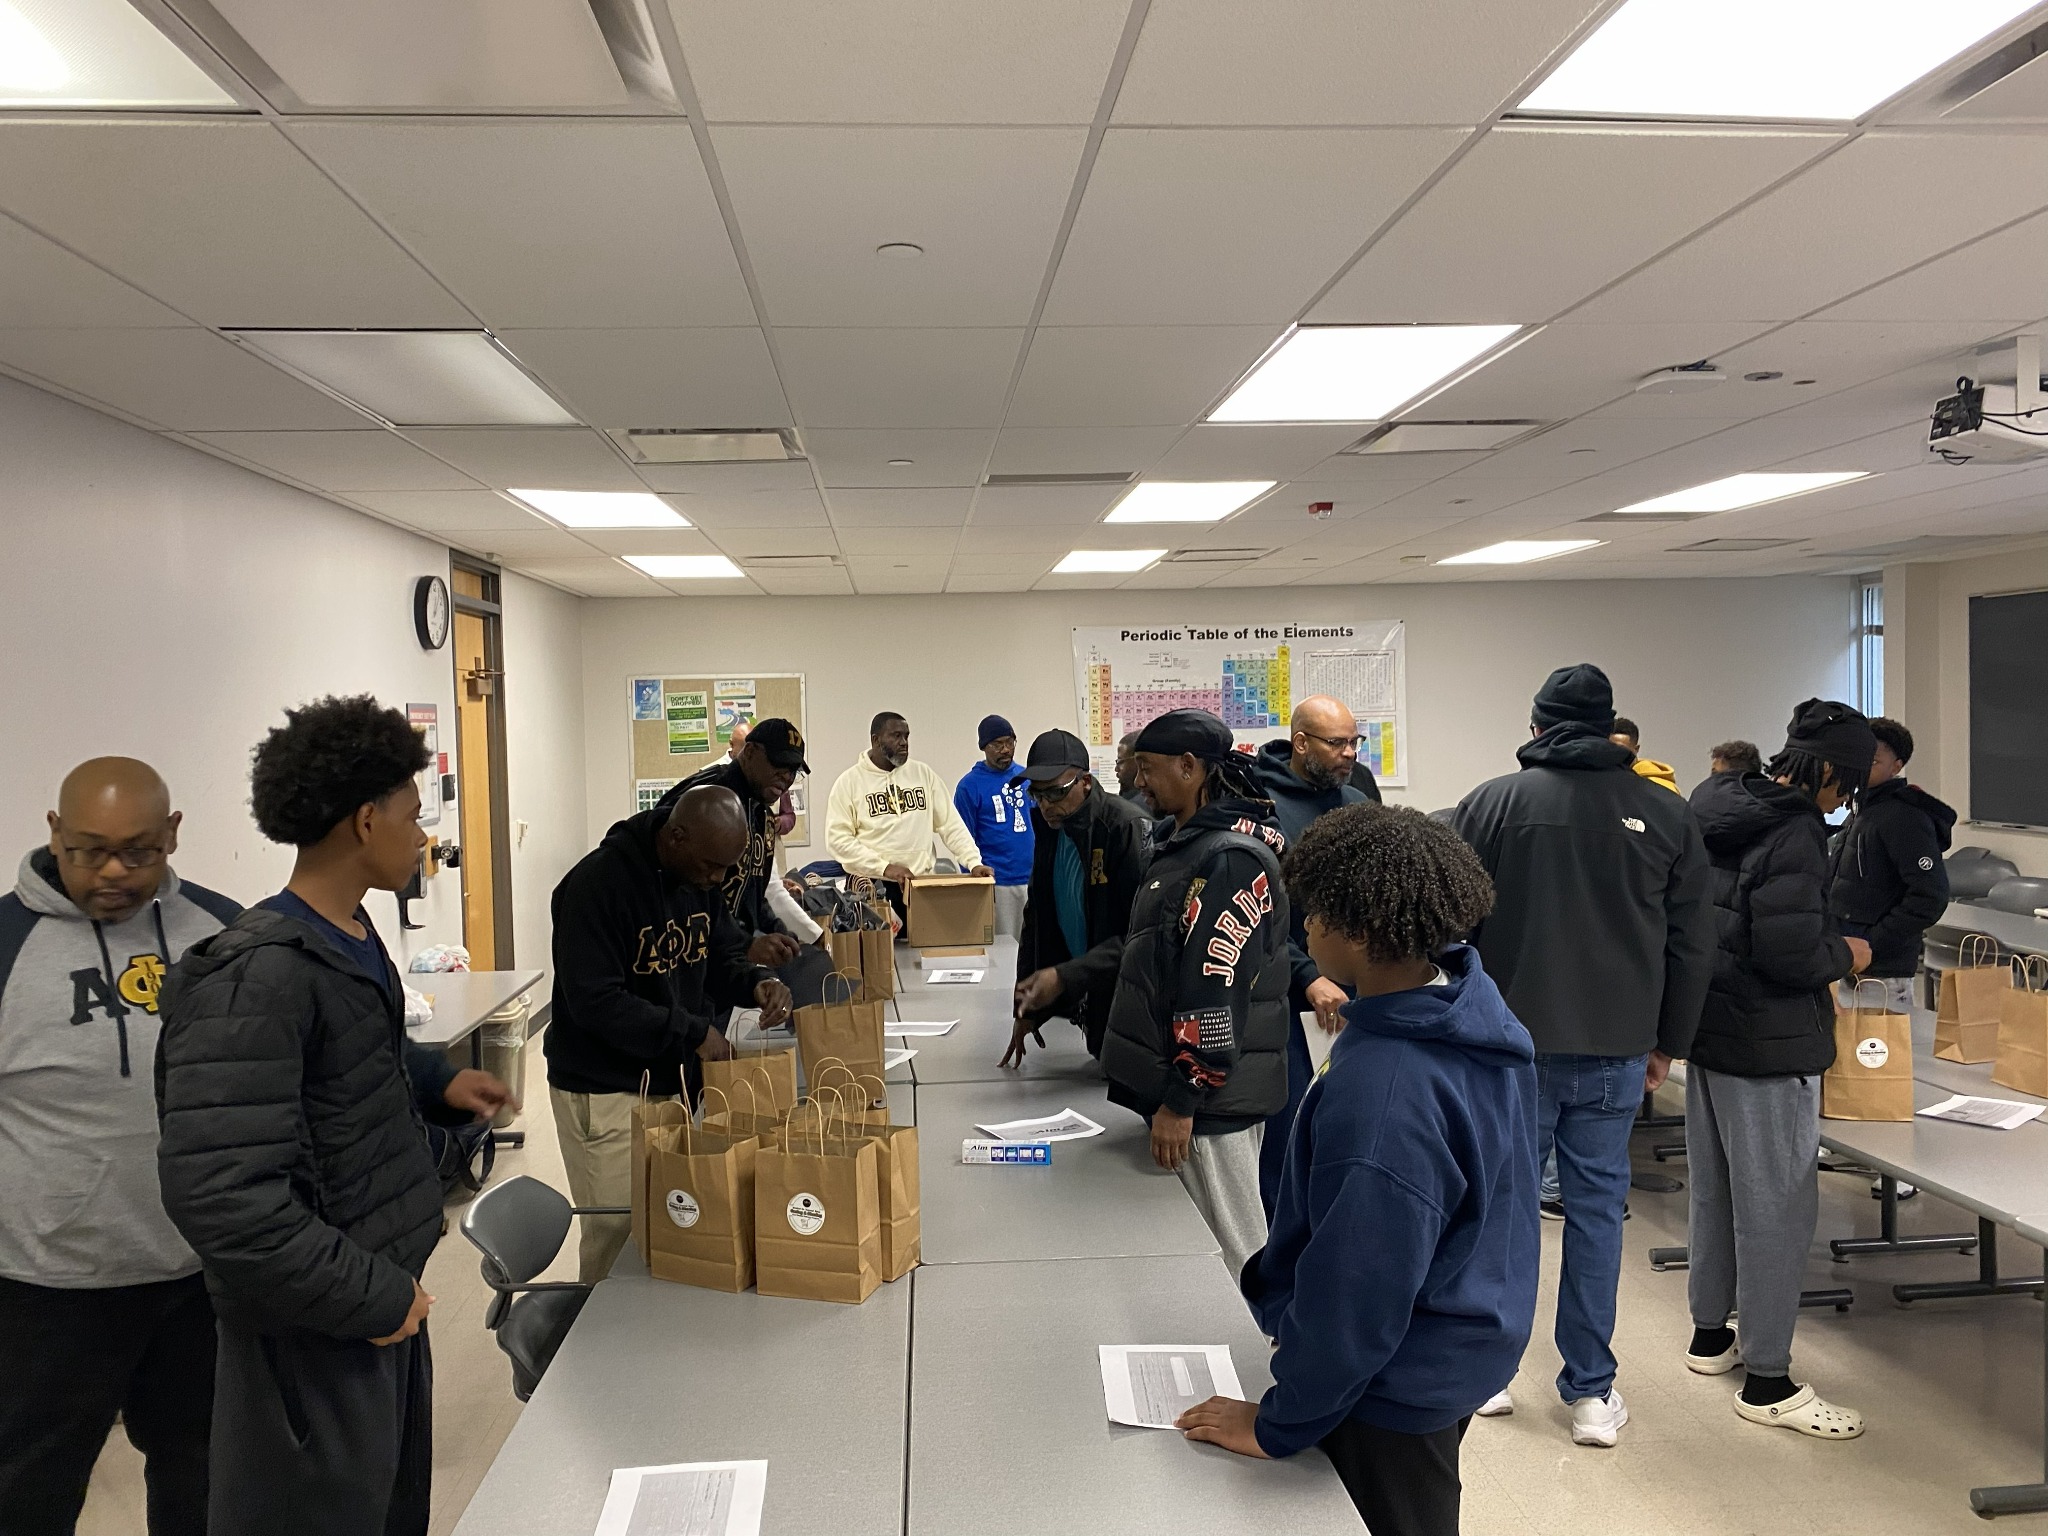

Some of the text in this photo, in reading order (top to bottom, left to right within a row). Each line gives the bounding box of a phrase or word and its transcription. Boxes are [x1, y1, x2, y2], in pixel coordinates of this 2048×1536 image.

[1121, 625, 1354, 642] Periodic Table of the Elements
